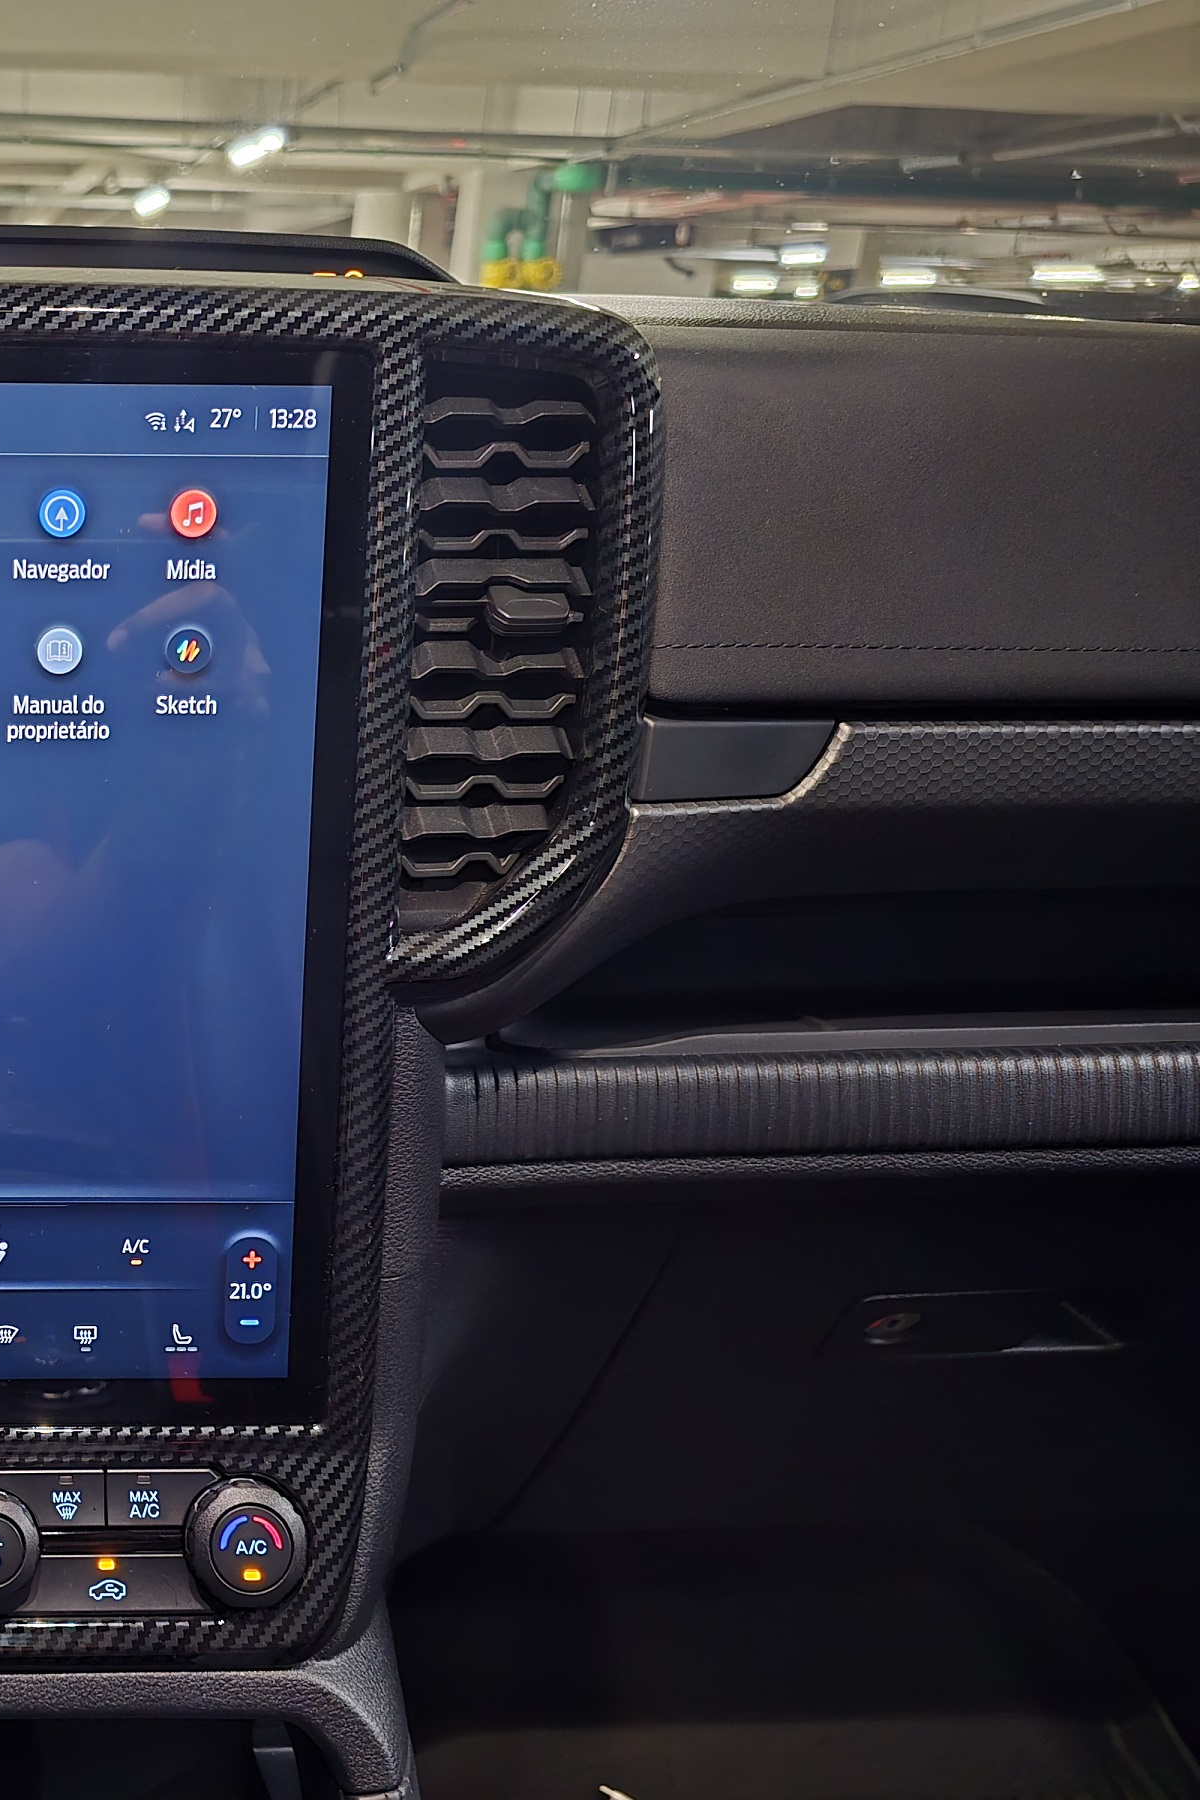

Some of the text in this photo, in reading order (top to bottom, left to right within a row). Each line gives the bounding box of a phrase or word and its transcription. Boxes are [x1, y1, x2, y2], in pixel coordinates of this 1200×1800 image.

[209, 408, 242, 429] 27°
[269, 408, 317, 429] 13:28
[12, 558, 111, 583] Navegador
[166, 559, 217, 580] Mídia
[13, 694, 105, 715] Manual do
[155, 694, 218, 715] Sketch
[6, 719, 110, 743] proprietário
[122, 1239, 150, 1254] A/C
[228, 1282, 272, 1300] 21.0°
[52, 1491, 82, 1503] MAX
[129, 1490, 160, 1503] MAX
[129, 1504, 161, 1519] A/C
[235, 1540, 268, 1555] A/C
